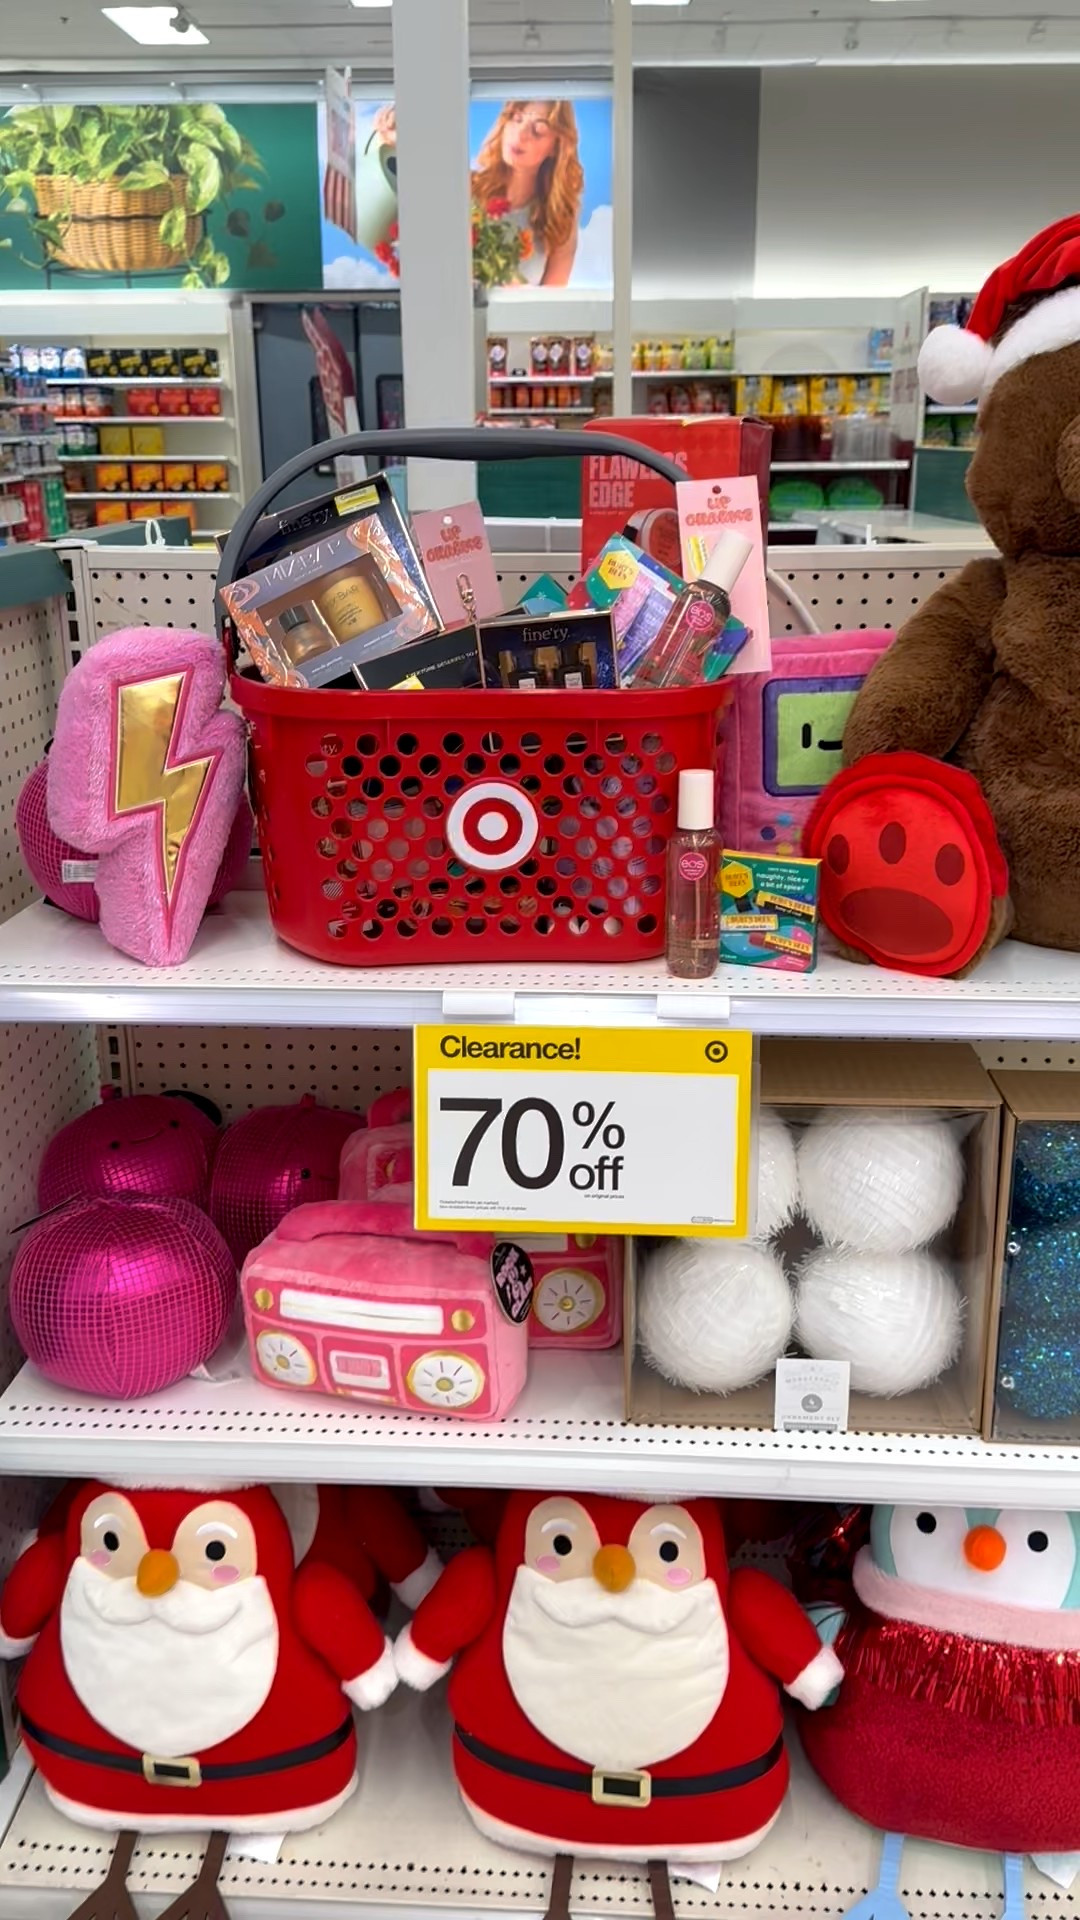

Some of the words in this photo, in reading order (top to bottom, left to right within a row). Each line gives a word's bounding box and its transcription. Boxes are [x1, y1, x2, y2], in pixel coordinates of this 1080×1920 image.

[590, 481, 635, 508] EDGE
[440, 525, 461, 542] LIP
[690, 605, 713, 622] eos
[681, 859, 705, 869] eos
[440, 1035, 581, 1060] Clearance!
[439, 1097, 565, 1190] 70
[569, 1156, 624, 1190] off
